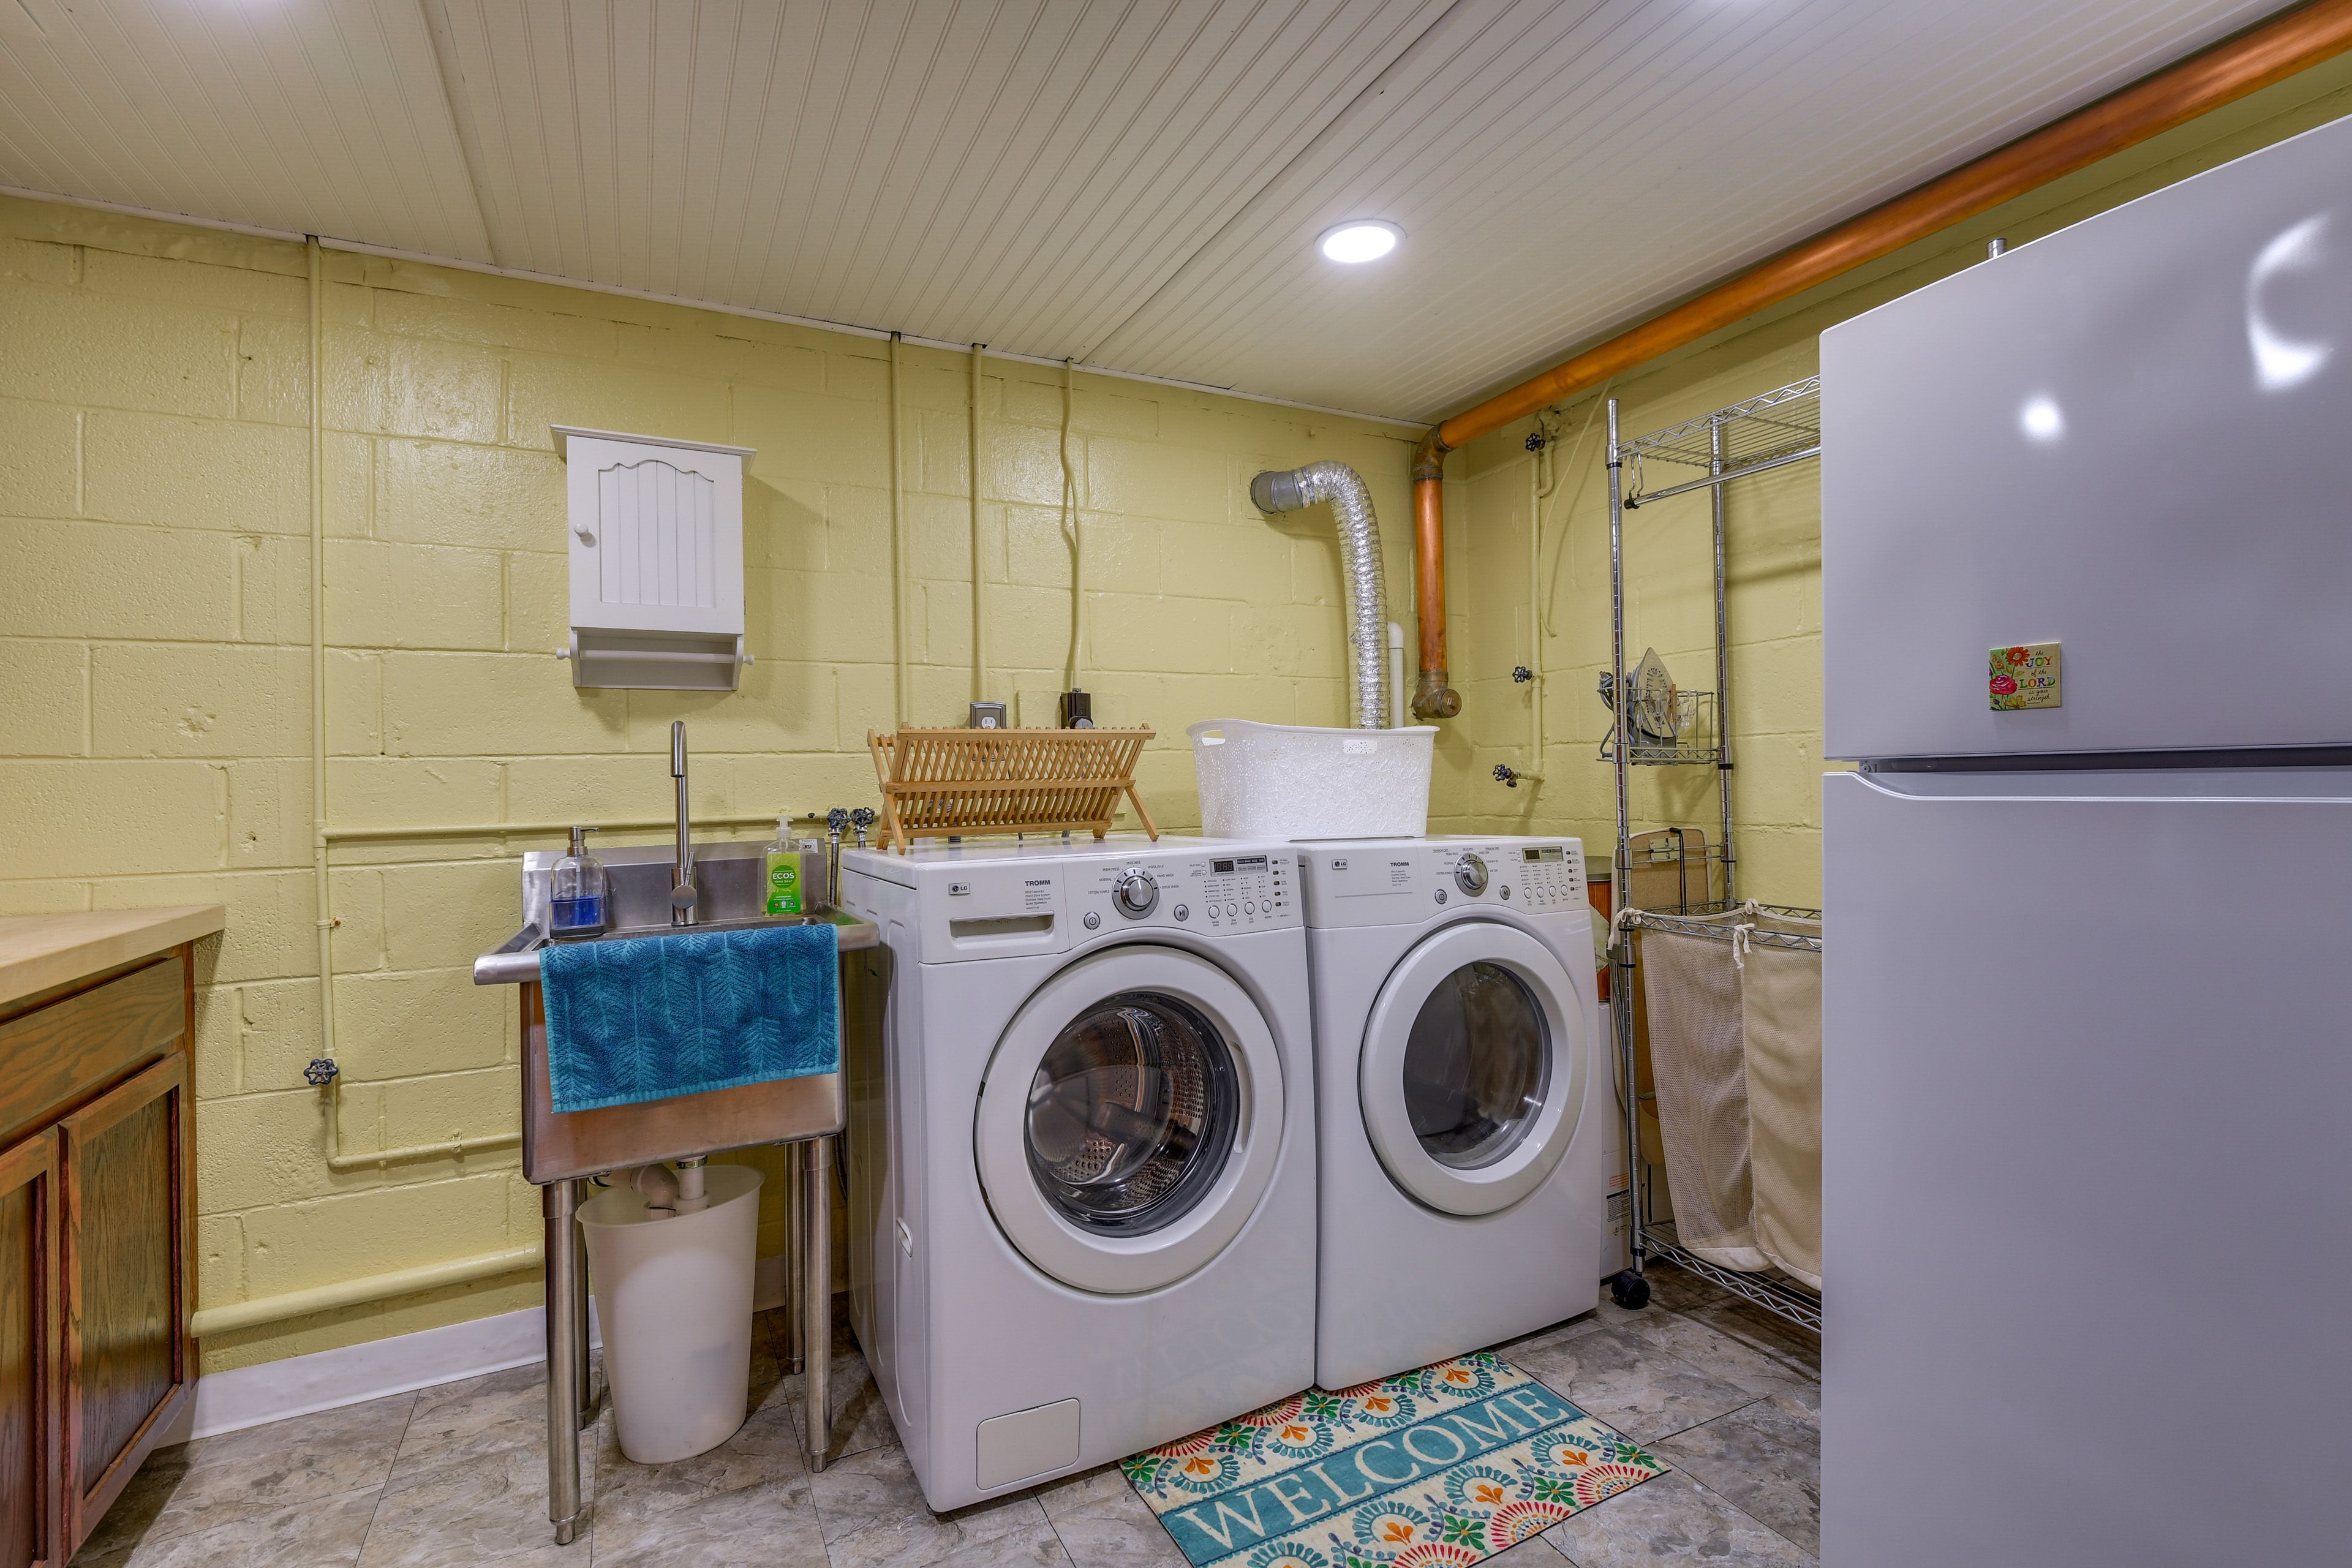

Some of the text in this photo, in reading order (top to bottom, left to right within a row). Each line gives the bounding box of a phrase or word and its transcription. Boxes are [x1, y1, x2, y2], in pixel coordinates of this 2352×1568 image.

[2026, 657, 2053, 667] JOY
[2031, 669, 2037, 677] of
[2019, 676, 2056, 688] LORD
[2027, 694, 2051, 703] strength
[1175, 1388, 1569, 1550] WELCOME
